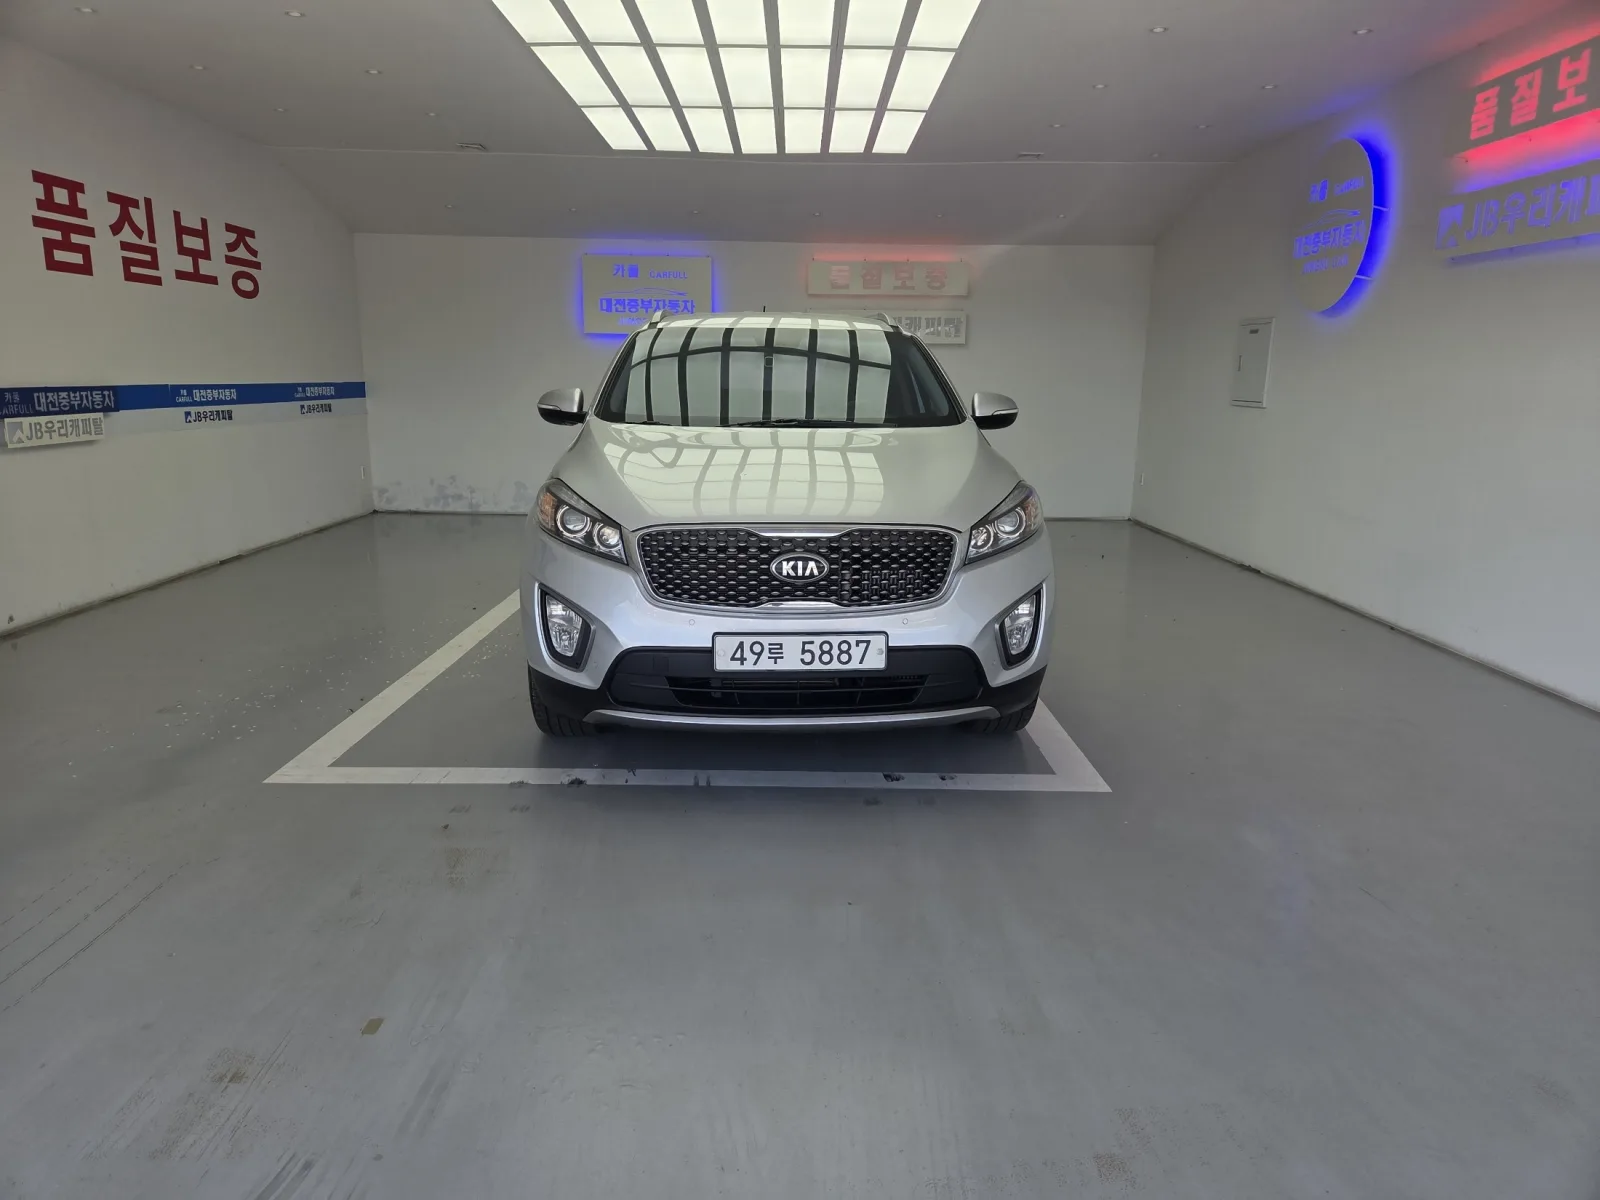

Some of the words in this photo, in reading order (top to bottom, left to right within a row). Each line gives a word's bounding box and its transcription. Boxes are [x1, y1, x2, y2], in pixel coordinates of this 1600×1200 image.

[31, 169, 262, 299] 품질보증
[649, 270, 688, 279] CARFULL
[599, 297, 695, 314] 대전중부자동차
[192, 388, 237, 402] 대전중부자동차
[305, 386, 335, 397] 대전중부자동차
[33, 390, 115, 412] 대전중부자동차
[0, 404, 34, 416] ARFULL
[192, 409, 233, 423] JB우리캐피탈
[26, 417, 104, 441] JB우리캐피탈
[781, 560, 819, 577] KIA
[730, 640, 784, 666] 49루
[800, 639, 872, 666] 5887
